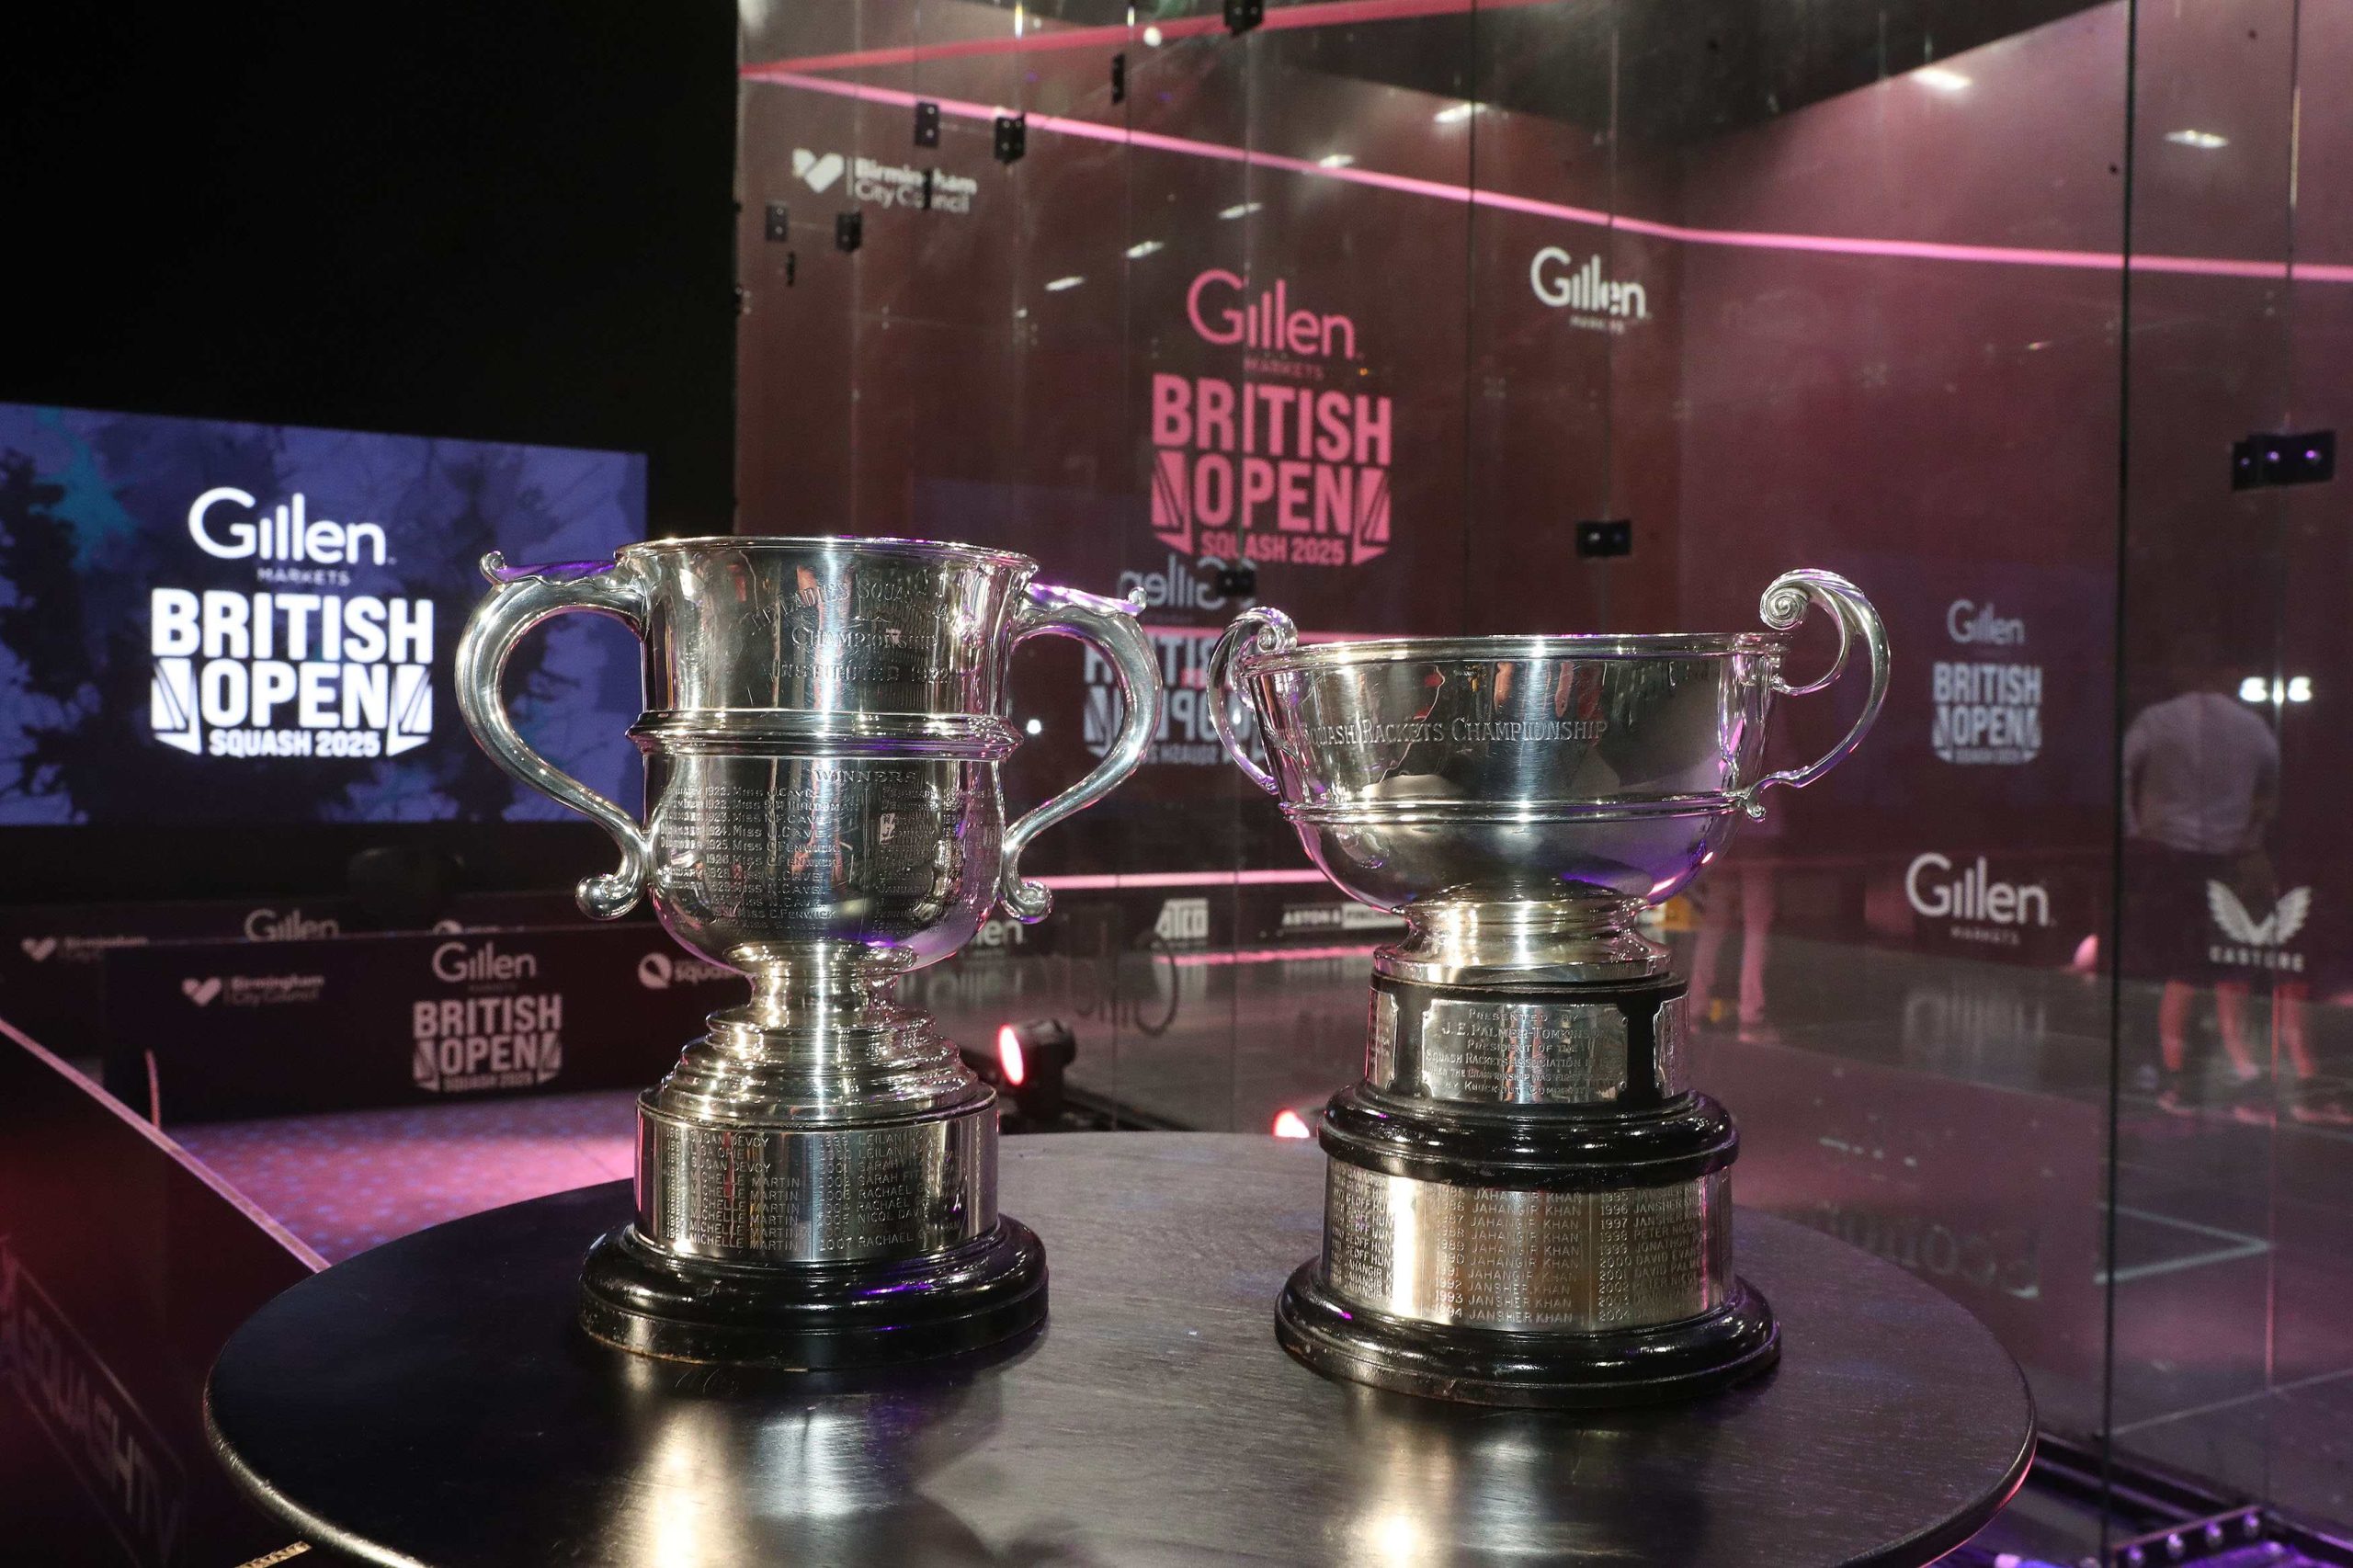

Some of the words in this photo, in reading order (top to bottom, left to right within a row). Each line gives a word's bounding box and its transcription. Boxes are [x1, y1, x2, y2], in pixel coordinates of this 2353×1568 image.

[1530, 246, 1646, 319] Gillen
[1187, 268, 1356, 359] Gillen
[1152, 372, 1392, 465] BRITISH
[1194, 453, 1351, 535] OPEN
[188, 487, 386, 565] Gillen
[1291, 538, 1347, 566] 2025
[256, 567, 350, 586] MARKETS
[152, 588, 433, 664] BRITISH
[1933, 662, 2042, 705] BRITISH
[201, 658, 388, 729] OPEN
[1361, 720, 1443, 744] RACKETS
[1451, 717, 1608, 742] CHAMPIONSHIP
[1952, 705, 2022, 745] OPEN
[210, 730, 311, 757] SQUASH
[315, 732, 381, 756] 2025
[815, 770, 917, 783] WINNERS
[1905, 852, 2049, 926] Gillen
[244, 908, 341, 943] Gillen
[432, 941, 537, 983] Gillen
[415, 994, 563, 1039] BRITISH
[440, 1034, 538, 1074] OPEN
[752, 1177, 800, 1187] MARTIN
[751, 1190, 798, 1201] MARTIN
[750, 1203, 800, 1214] MARTIN
[1472, 1203, 1538, 1216] JAHANGIR
[1545, 1206, 1581, 1217] KHAN
[1601, 1205, 1628, 1215] 1996
[751, 1215, 798, 1225] MARTIN
[1543, 1220, 1579, 1230] KHAN
[1601, 1218, 1628, 1230] 1997
[750, 1228, 798, 1238] MARTIN
[1543, 1233, 1579, 1243] KHAN
[750, 1241, 798, 1251] MARTIN
[820, 1237, 852, 1252] 2007
[1544, 1245, 1580, 1256] KHAN
[1471, 1256, 1537, 1268] JAHANGIR
[1542, 1258, 1579, 1269] KHAN
[1468, 1269, 1533, 1281] JAHANGIR
[1436, 1290, 1463, 1304] 1993
[1468, 1295, 1529, 1308] JANSHER
[1536, 1298, 1572, 1309] KHAN
[1469, 1309, 1531, 1324] JANSHER
[1536, 1312, 1573, 1324] KHAN
